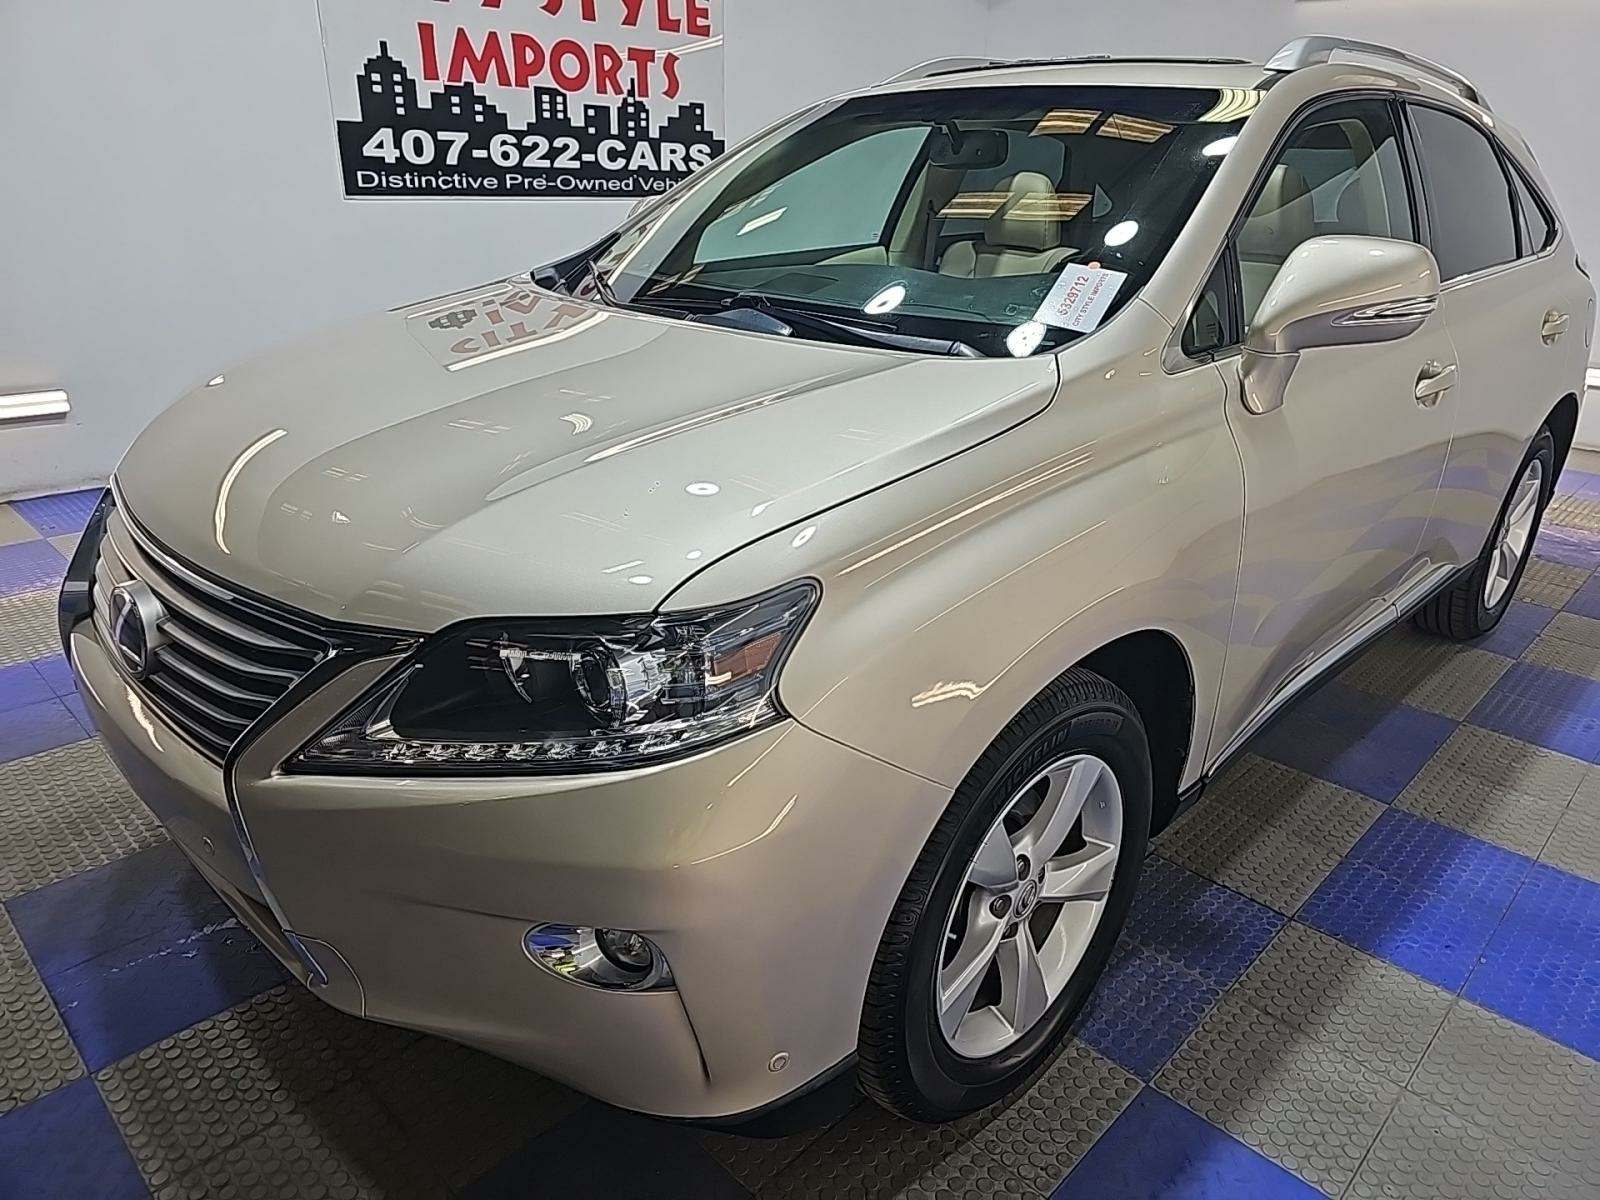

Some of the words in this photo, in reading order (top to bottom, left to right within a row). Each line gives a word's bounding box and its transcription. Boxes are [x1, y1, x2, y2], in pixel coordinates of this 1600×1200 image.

[417, 22, 681, 100] IMPORTS
[362, 127, 712, 172] 407-622-CARS
[356, 170, 499, 190] Distinctive
[505, 173, 634, 191] Pre-Owned
[1072, 313, 1084, 327] CITY
[1080, 296, 1095, 313] STYLE
